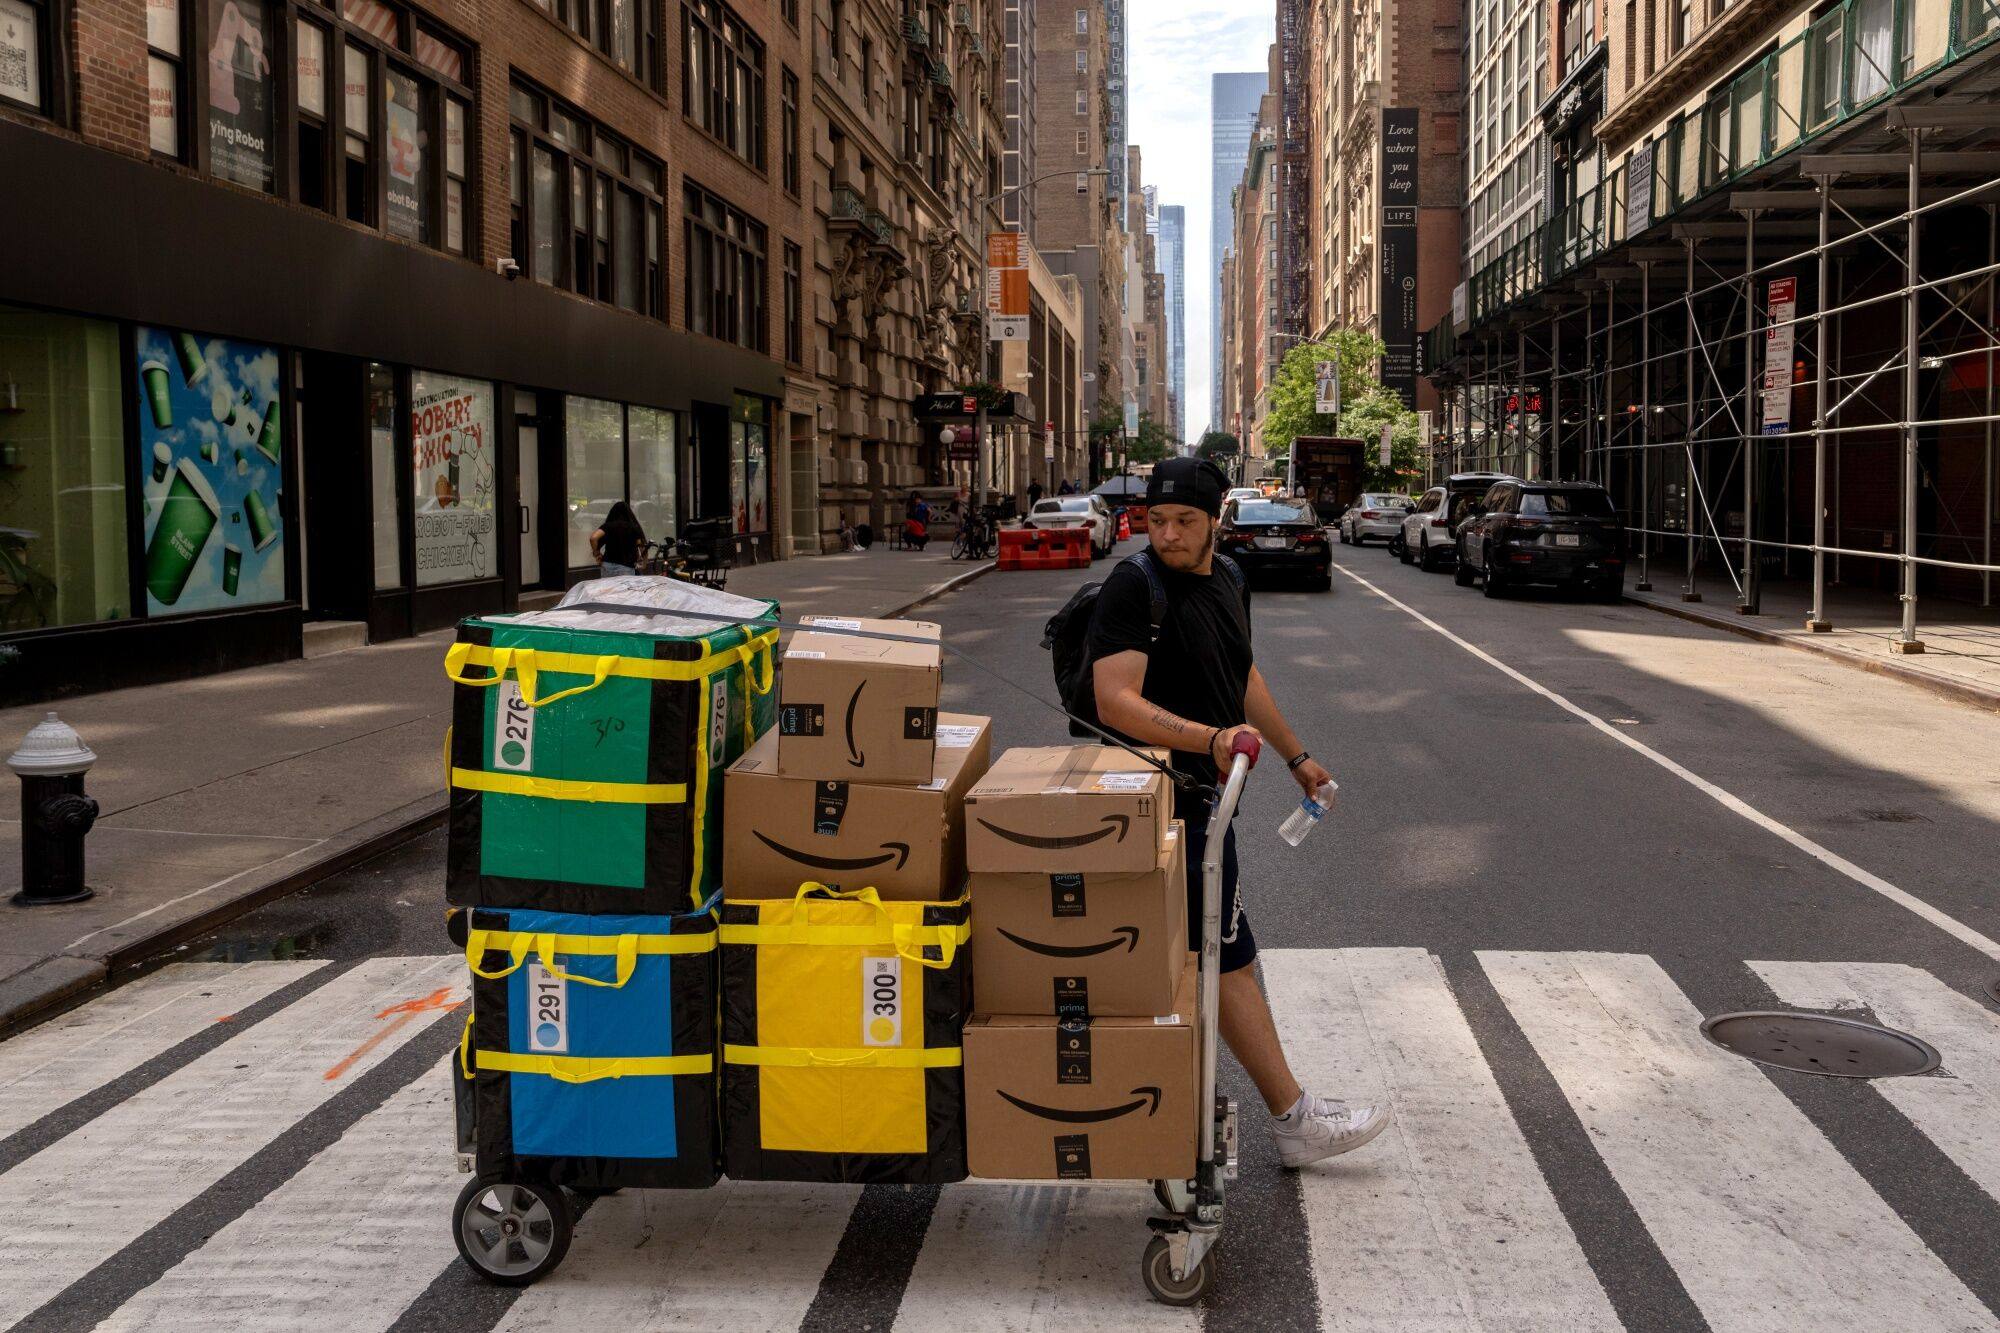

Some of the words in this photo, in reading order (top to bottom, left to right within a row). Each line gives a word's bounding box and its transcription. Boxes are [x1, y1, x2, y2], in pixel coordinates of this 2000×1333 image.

[235, 128, 265, 152] Robot
[1387, 124, 1414, 135] Love
[1386, 142, 1416, 153] where
[1390, 163, 1409, 175] you
[1388, 179, 1412, 193] sleep
[405, 196, 419, 211] Bar
[1387, 212, 1412, 220] LIFE
[1017, 232, 1029, 270] NOMAD
[989, 267, 1001, 315] FLATIRON
[412, 395, 473, 441] ROBERT
[412, 422, 482, 471] CHICN
[415, 513, 493, 538] ROBOT-FRIED
[170, 535, 193, 561] STREET
[417, 545, 474, 570] CHICKEN
[505, 697, 529, 740] 276
[714, 696, 725, 738] 276
[788, 707, 798, 733] prime
[537, 983, 560, 1022] 291
[873, 973, 896, 1016] 300
[1059, 1003, 1085, 1013] prime
